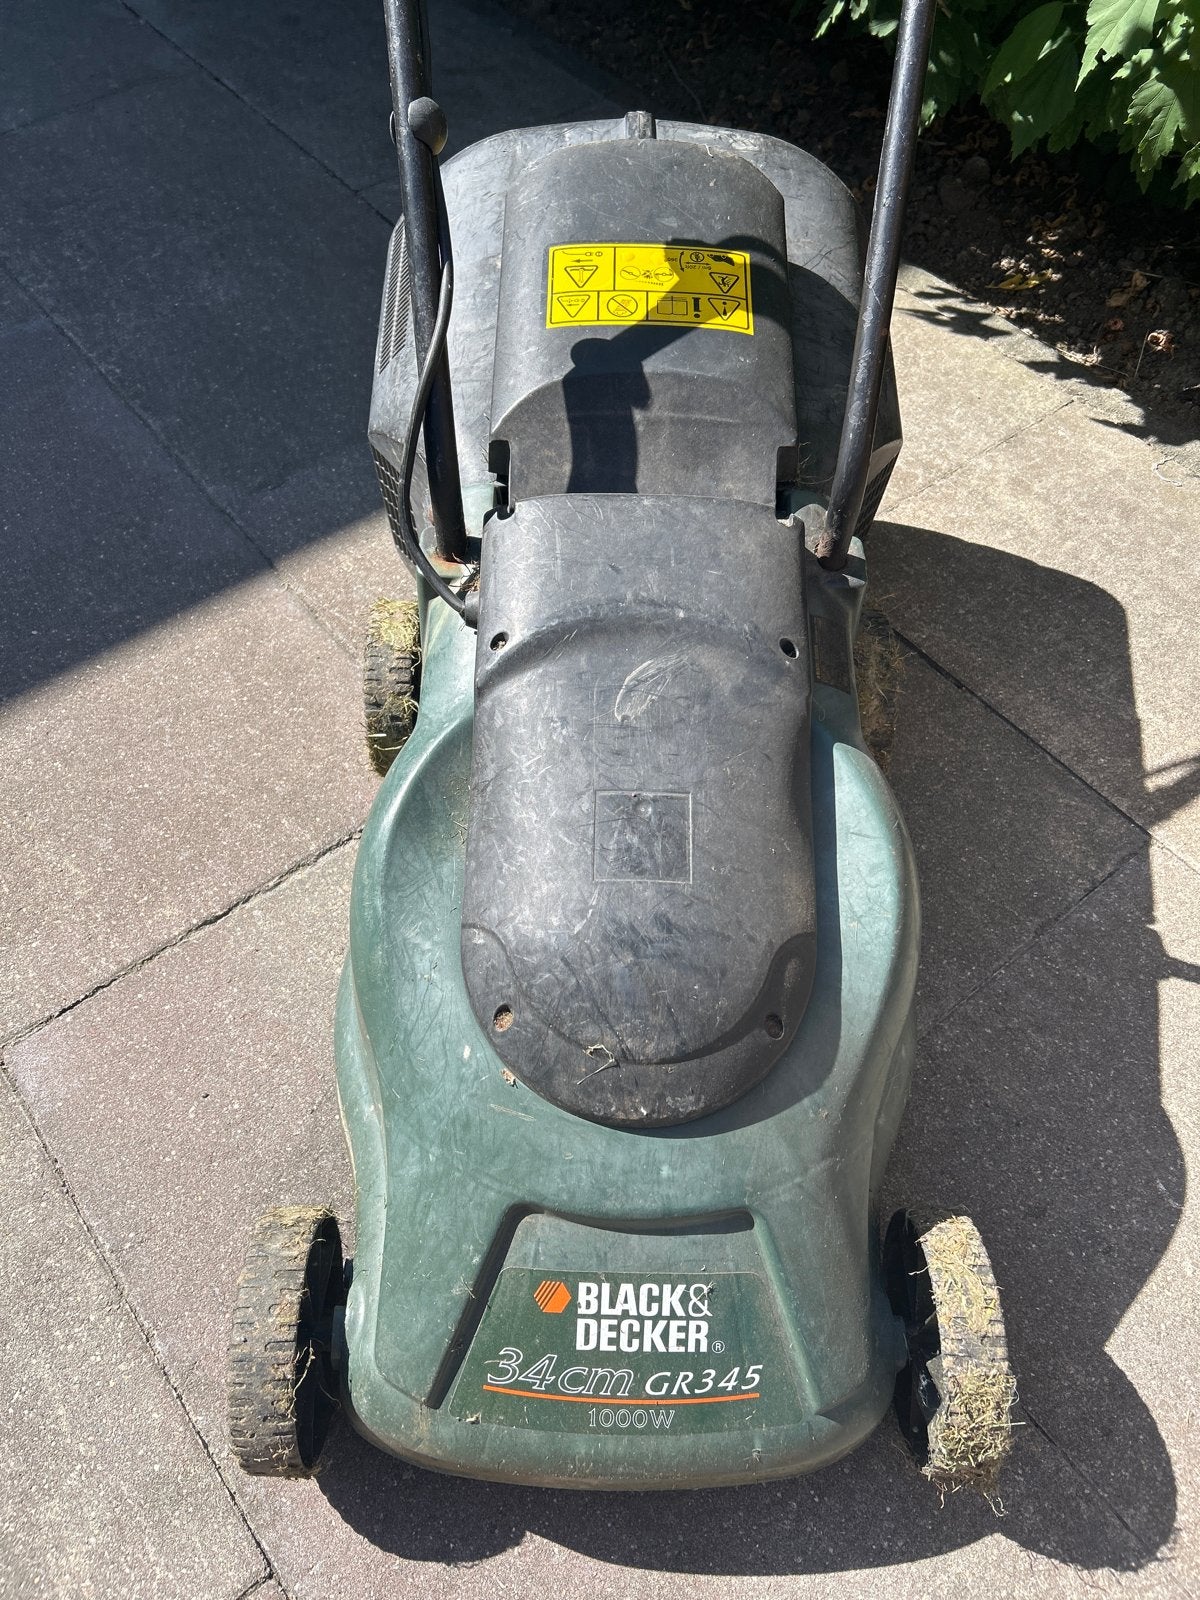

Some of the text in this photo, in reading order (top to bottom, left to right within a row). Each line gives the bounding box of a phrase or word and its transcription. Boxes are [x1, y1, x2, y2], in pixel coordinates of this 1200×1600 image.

[575, 1318, 709, 1353] DECKER
[487, 1347, 764, 1397] 34cm GR345
[588, 1407, 676, 1430] 1000W
